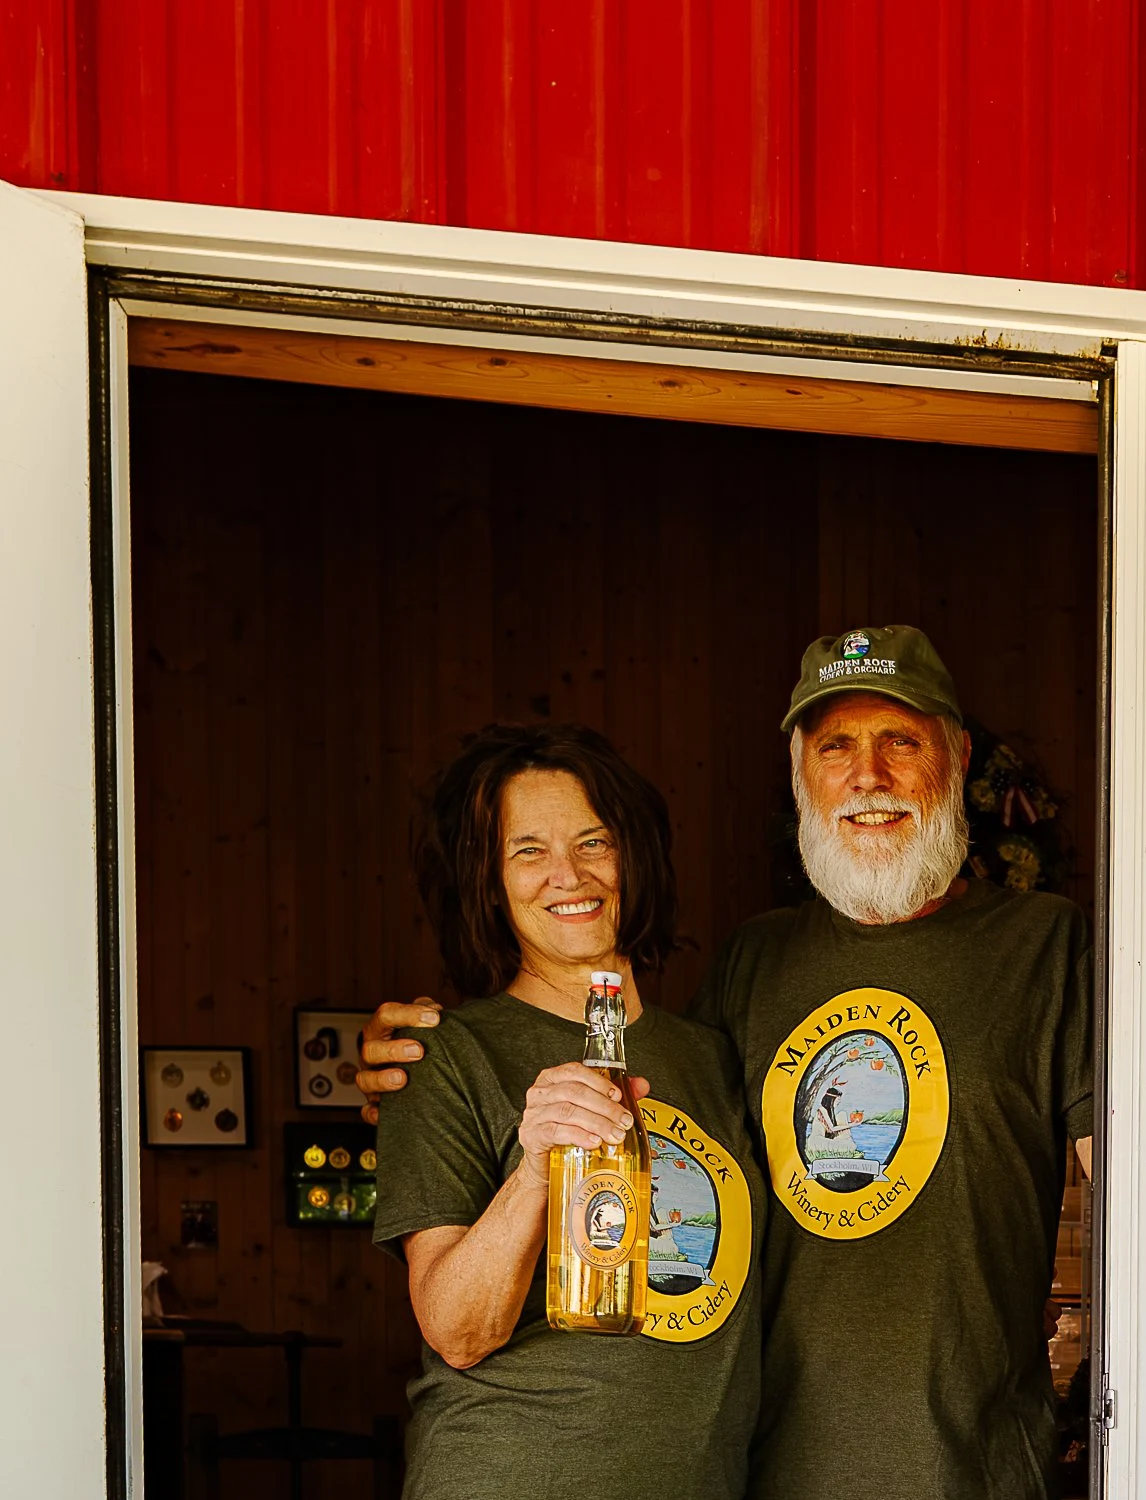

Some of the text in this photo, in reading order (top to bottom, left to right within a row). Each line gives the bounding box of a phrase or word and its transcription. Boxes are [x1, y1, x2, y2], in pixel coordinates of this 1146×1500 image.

[819, 659, 895, 677] MAIDEN ROCK
[820, 666, 895, 683] CIDERY & ORCHARD
[775, 1005, 931, 1079] MAIDEN ROCK
[667, 1114, 734, 1184] ROCK
[575, 1181, 635, 1214] MAIDEN ROCK
[786, 1171, 911, 1230] Winery & Cidery
[581, 1243, 599, 1263] Winery
[609, 1246, 628, 1261] Cidery
[667, 1312, 685, 1330] &
[687, 1280, 732, 1325] Cidery
